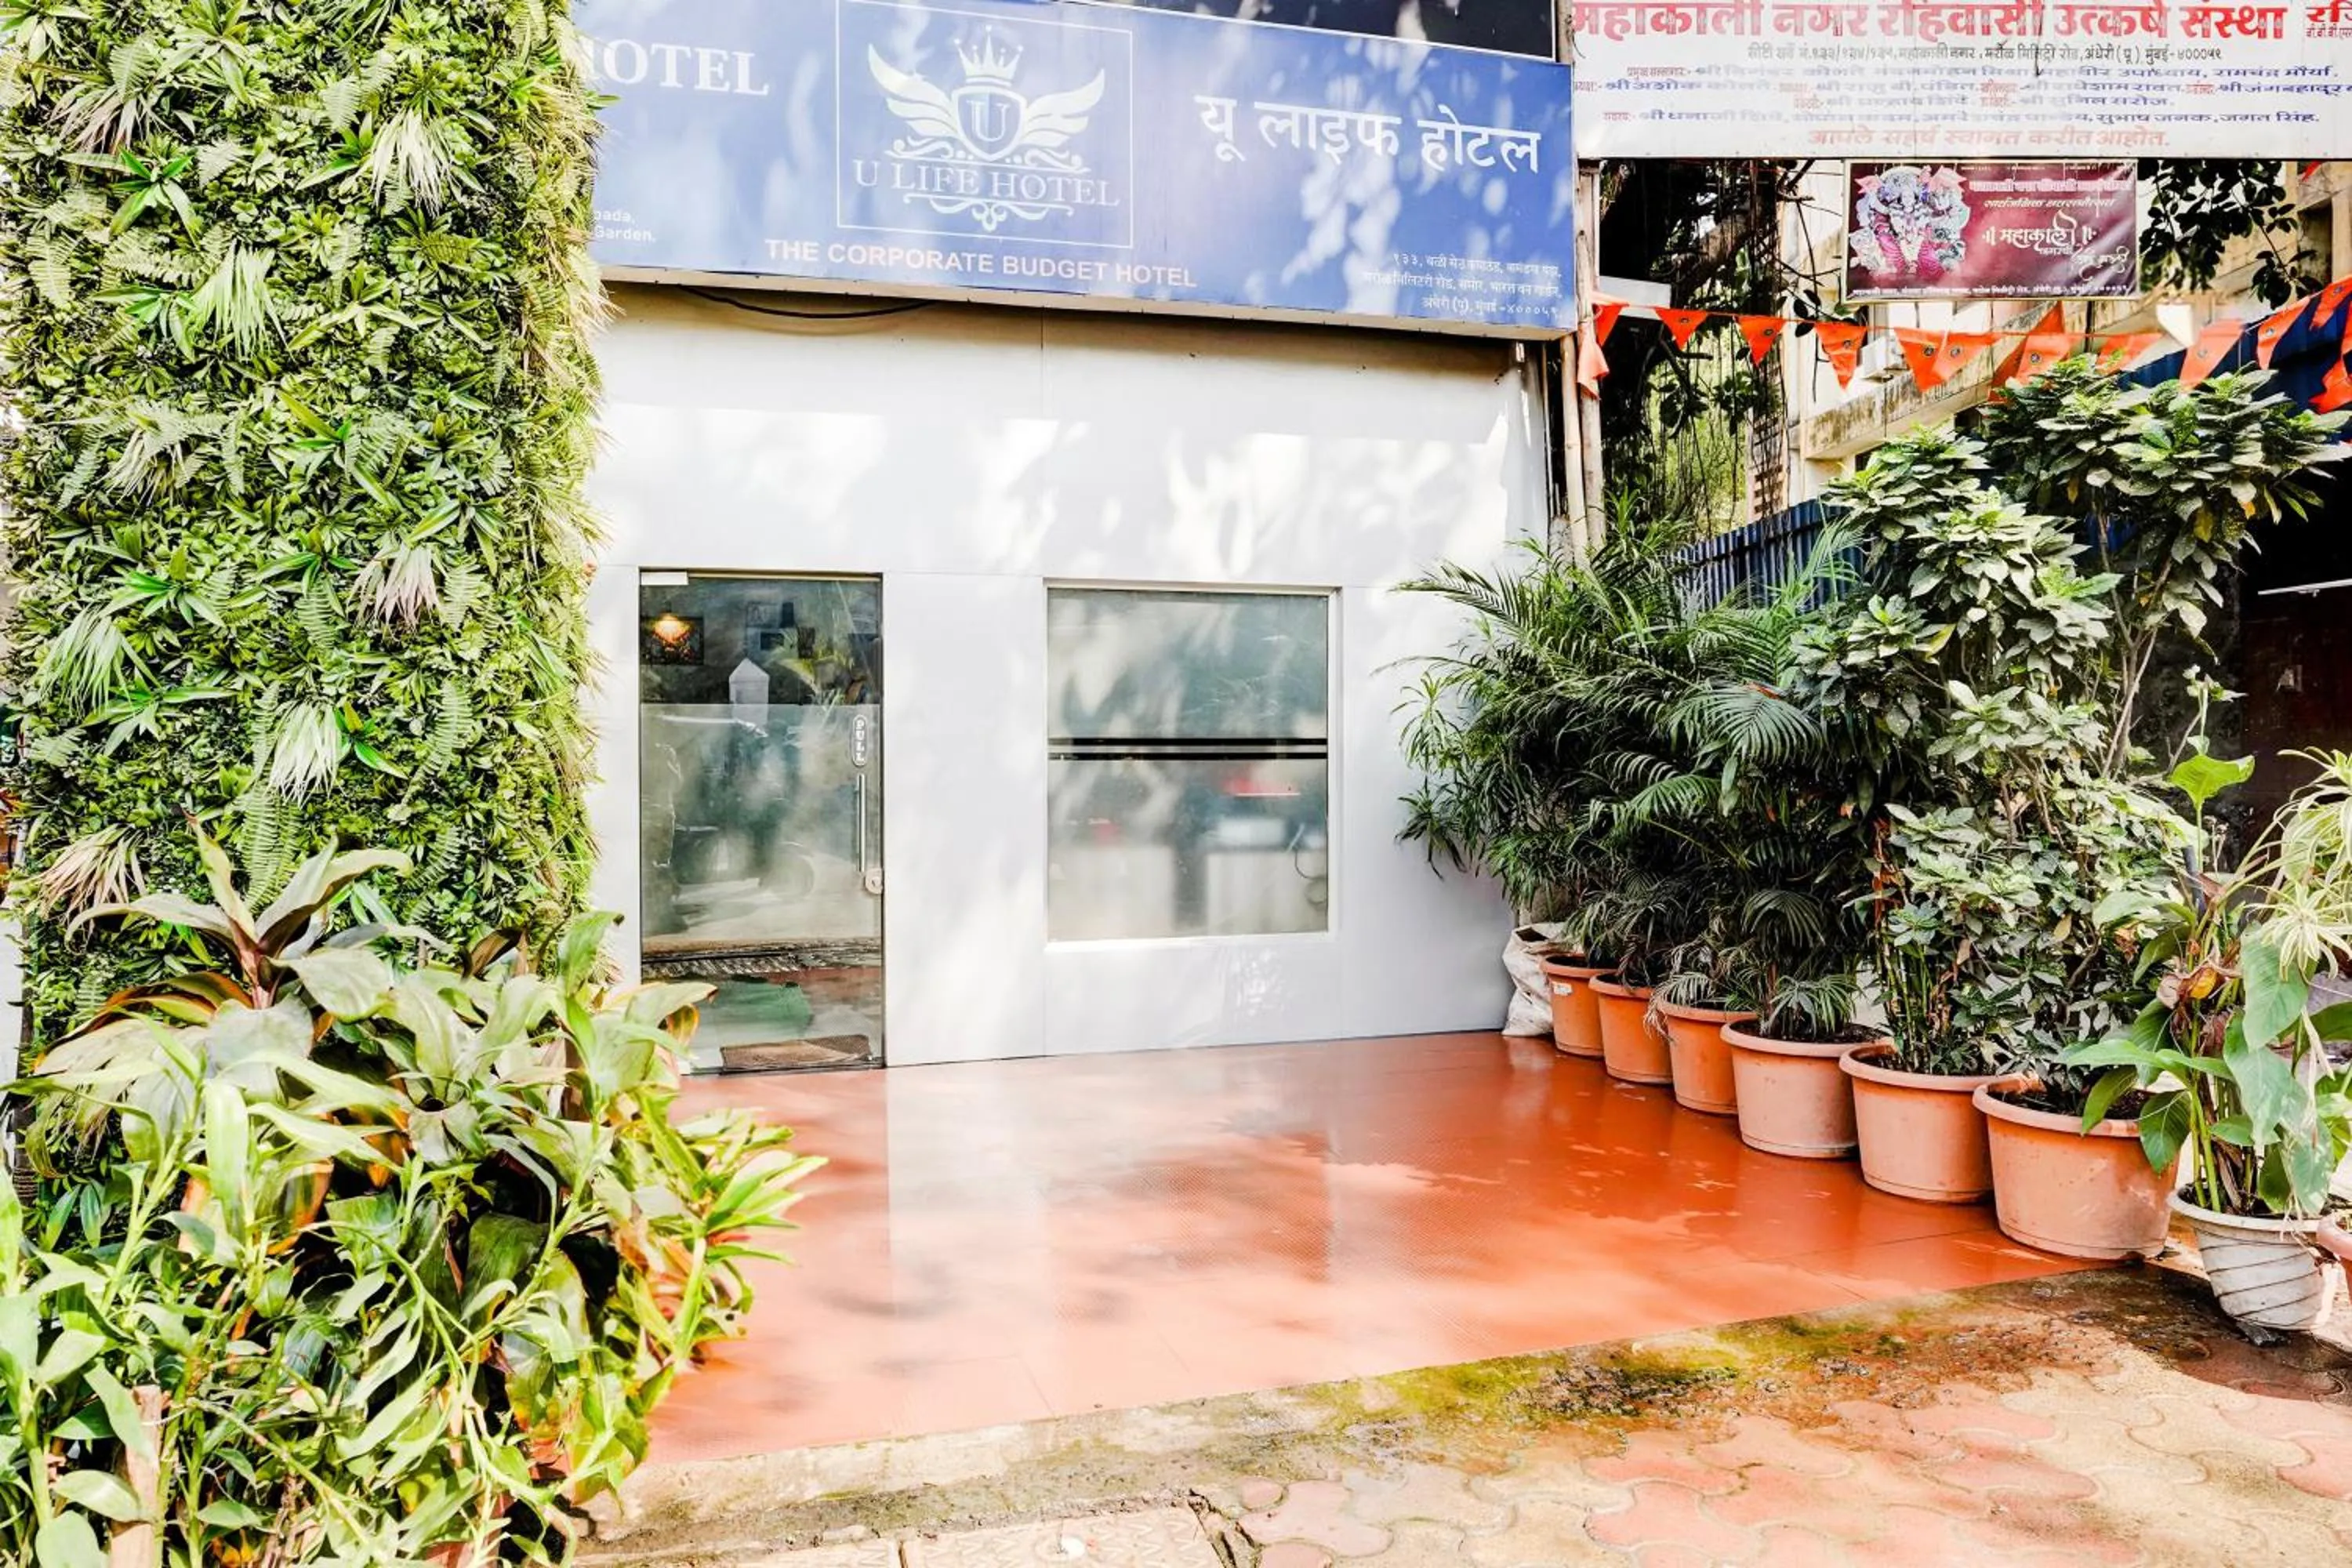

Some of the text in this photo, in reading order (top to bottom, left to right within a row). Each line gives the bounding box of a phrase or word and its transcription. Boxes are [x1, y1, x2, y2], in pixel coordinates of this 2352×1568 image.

[1771, 3, 1869, 37] नगर
[2180, 0, 2288, 39] संस्था
[967, 100, 1011, 142] U
[1195, 94, 1541, 173] यू लाइफ होटल
[1808, 123, 1875, 145] आपले
[1945, 129, 2022, 146] स्वागत
[2027, 123, 2094, 146] करीत
[852, 159, 1120, 207] U LIFE HOTEL
[1999, 209, 2078, 251] महाकाली
[764, 238, 1198, 288] THE CORPORATE BUDGET HOTEL
[855, 719, 865, 761] PULL
